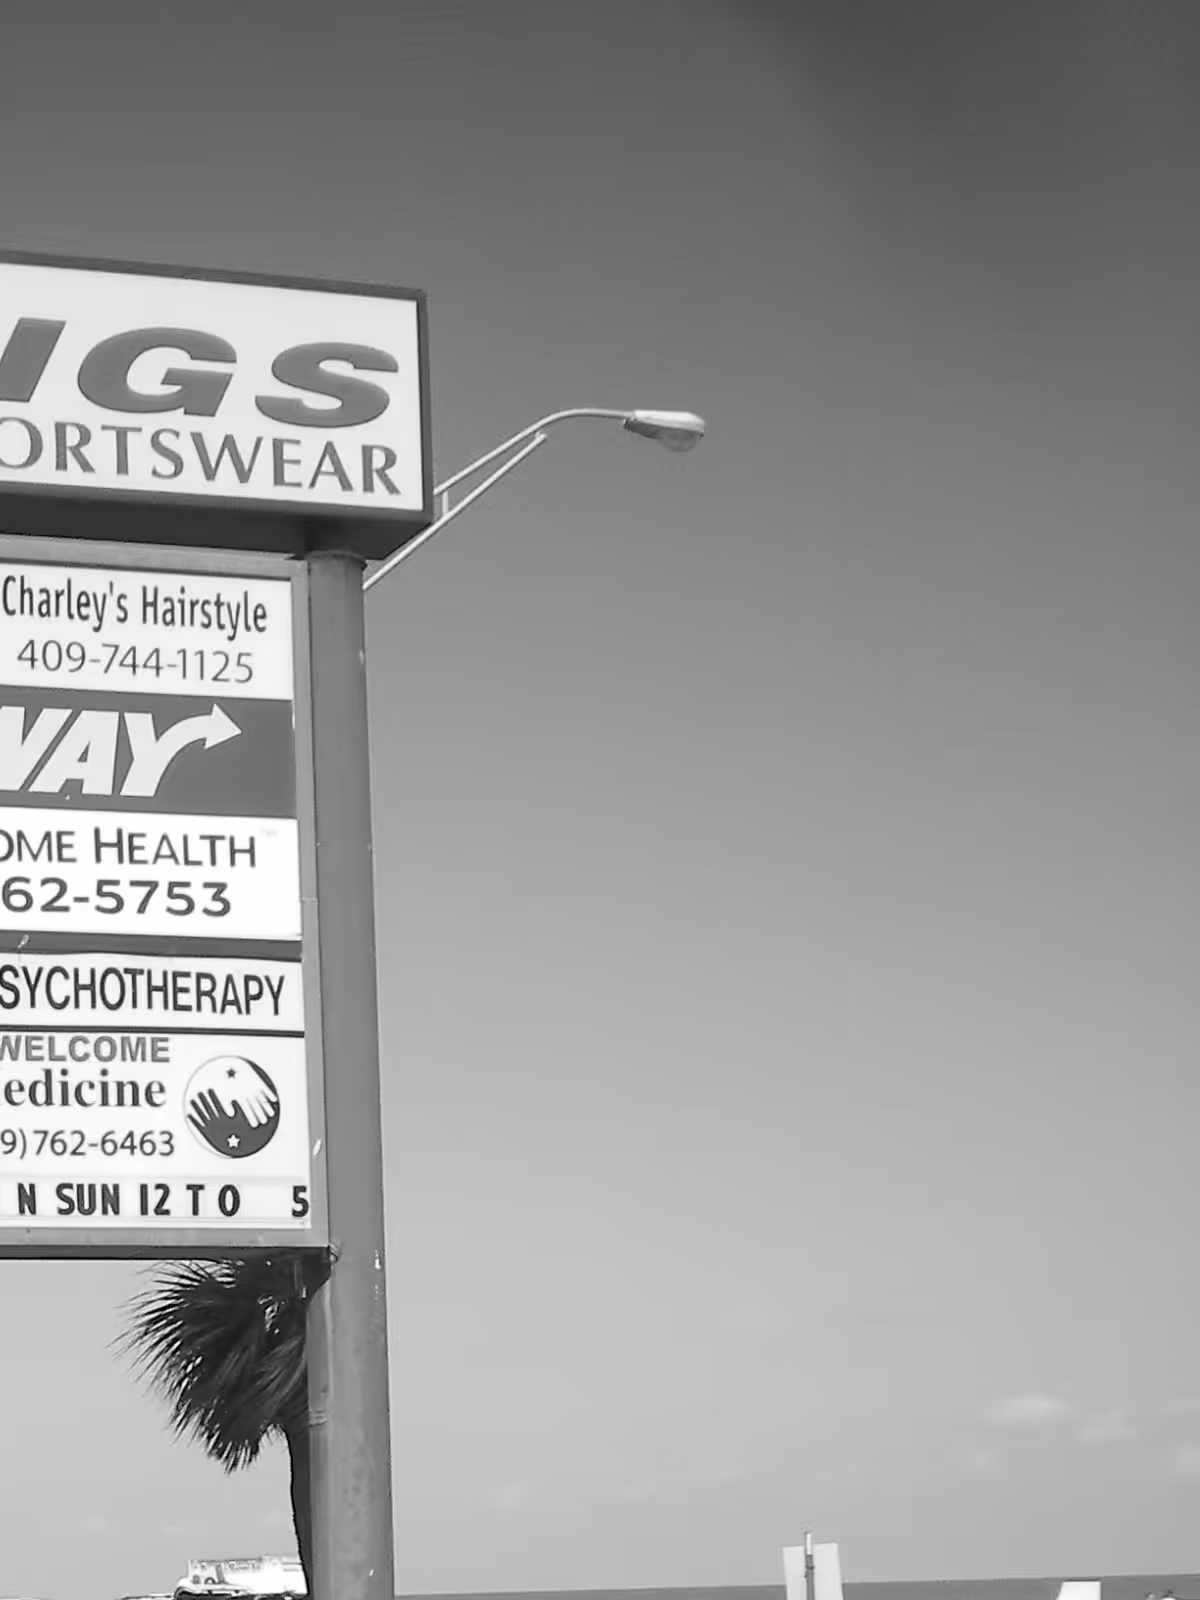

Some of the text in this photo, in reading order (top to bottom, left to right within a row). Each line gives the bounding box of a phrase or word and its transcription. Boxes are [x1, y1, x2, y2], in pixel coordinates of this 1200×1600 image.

[1, 574, 268, 641] Charley's Hairstyle
[16, 638, 254, 684] 409-744-1125
[94, 826, 257, 868] HEALTH
[56, 1182, 121, 1217] SUN
[138, 1183, 171, 1217] 12
[291, 1184, 310, 1218] 5
